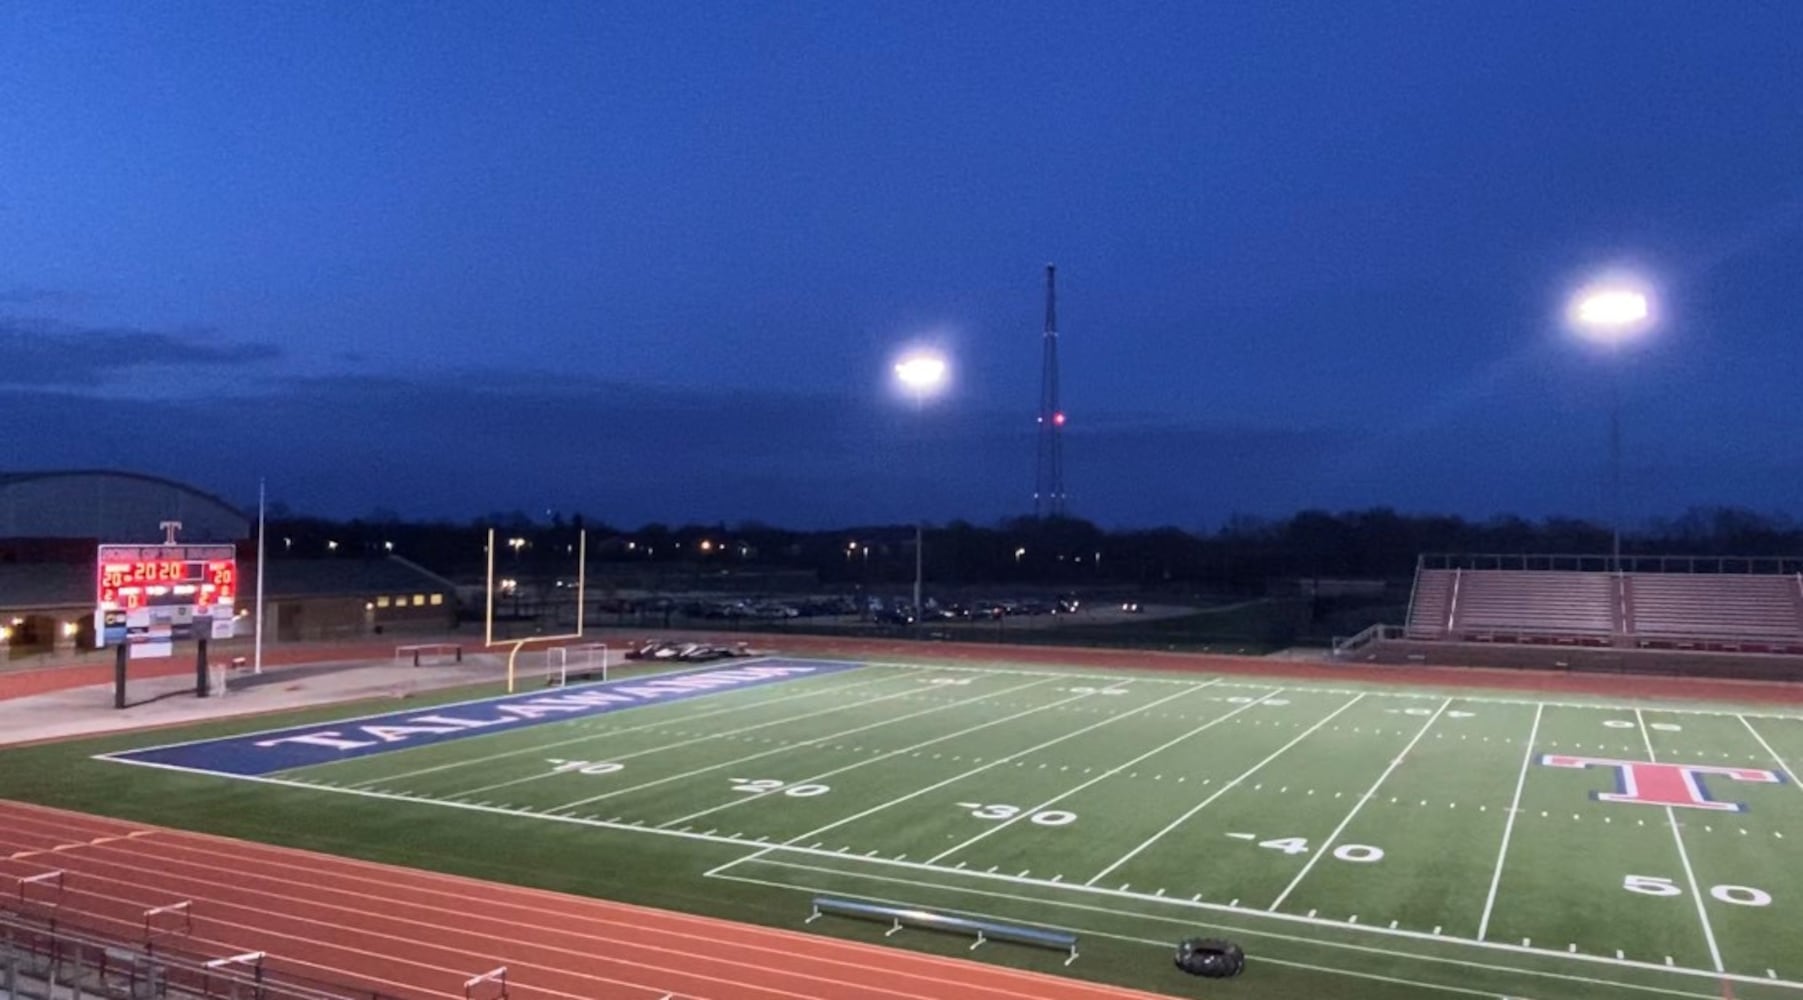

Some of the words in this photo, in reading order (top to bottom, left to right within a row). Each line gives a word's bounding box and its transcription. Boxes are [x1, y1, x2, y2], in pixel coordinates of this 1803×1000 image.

[159, 521, 182, 546] T
[103, 573, 122, 587] 20
[214, 570, 232, 583] 20
[1534, 754, 1788, 812] T
[971, 804, 1078, 826] 30
[1258, 837, 1385, 862] 40
[1623, 874, 1773, 907] 50
